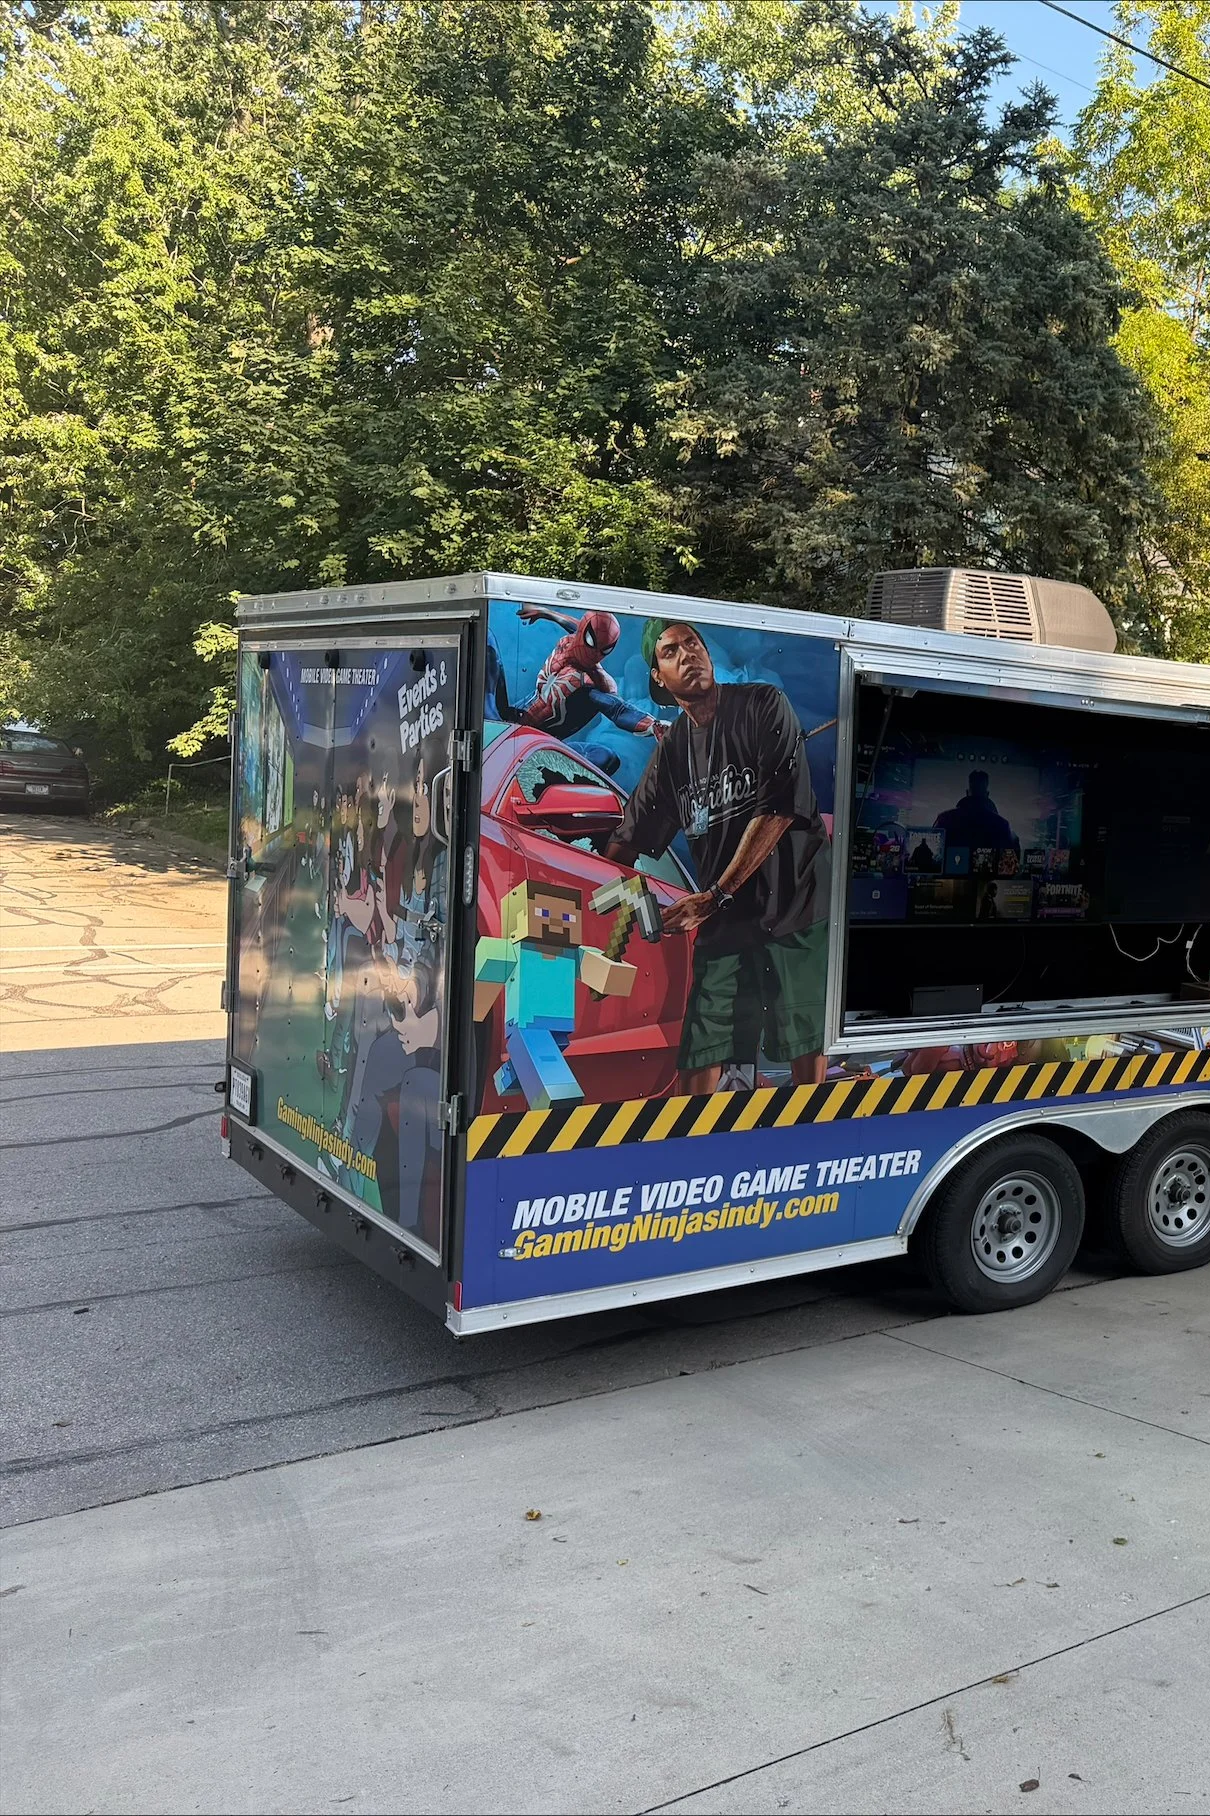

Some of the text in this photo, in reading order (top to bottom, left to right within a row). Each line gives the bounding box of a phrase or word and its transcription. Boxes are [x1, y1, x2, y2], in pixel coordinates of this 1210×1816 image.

[300, 668, 320, 684] MOBILE
[336, 668, 351, 684] GAME
[352, 668, 377, 685] THEATER
[398, 660, 448, 720] Events &
[400, 702, 444, 755] Parties
[277, 1096, 377, 1181] GamingNinjasindy.com
[512, 1149, 922, 1231] MOBILE VIDEO GAME THEATER
[513, 1191, 840, 1260] GamingNinjasindy.com
